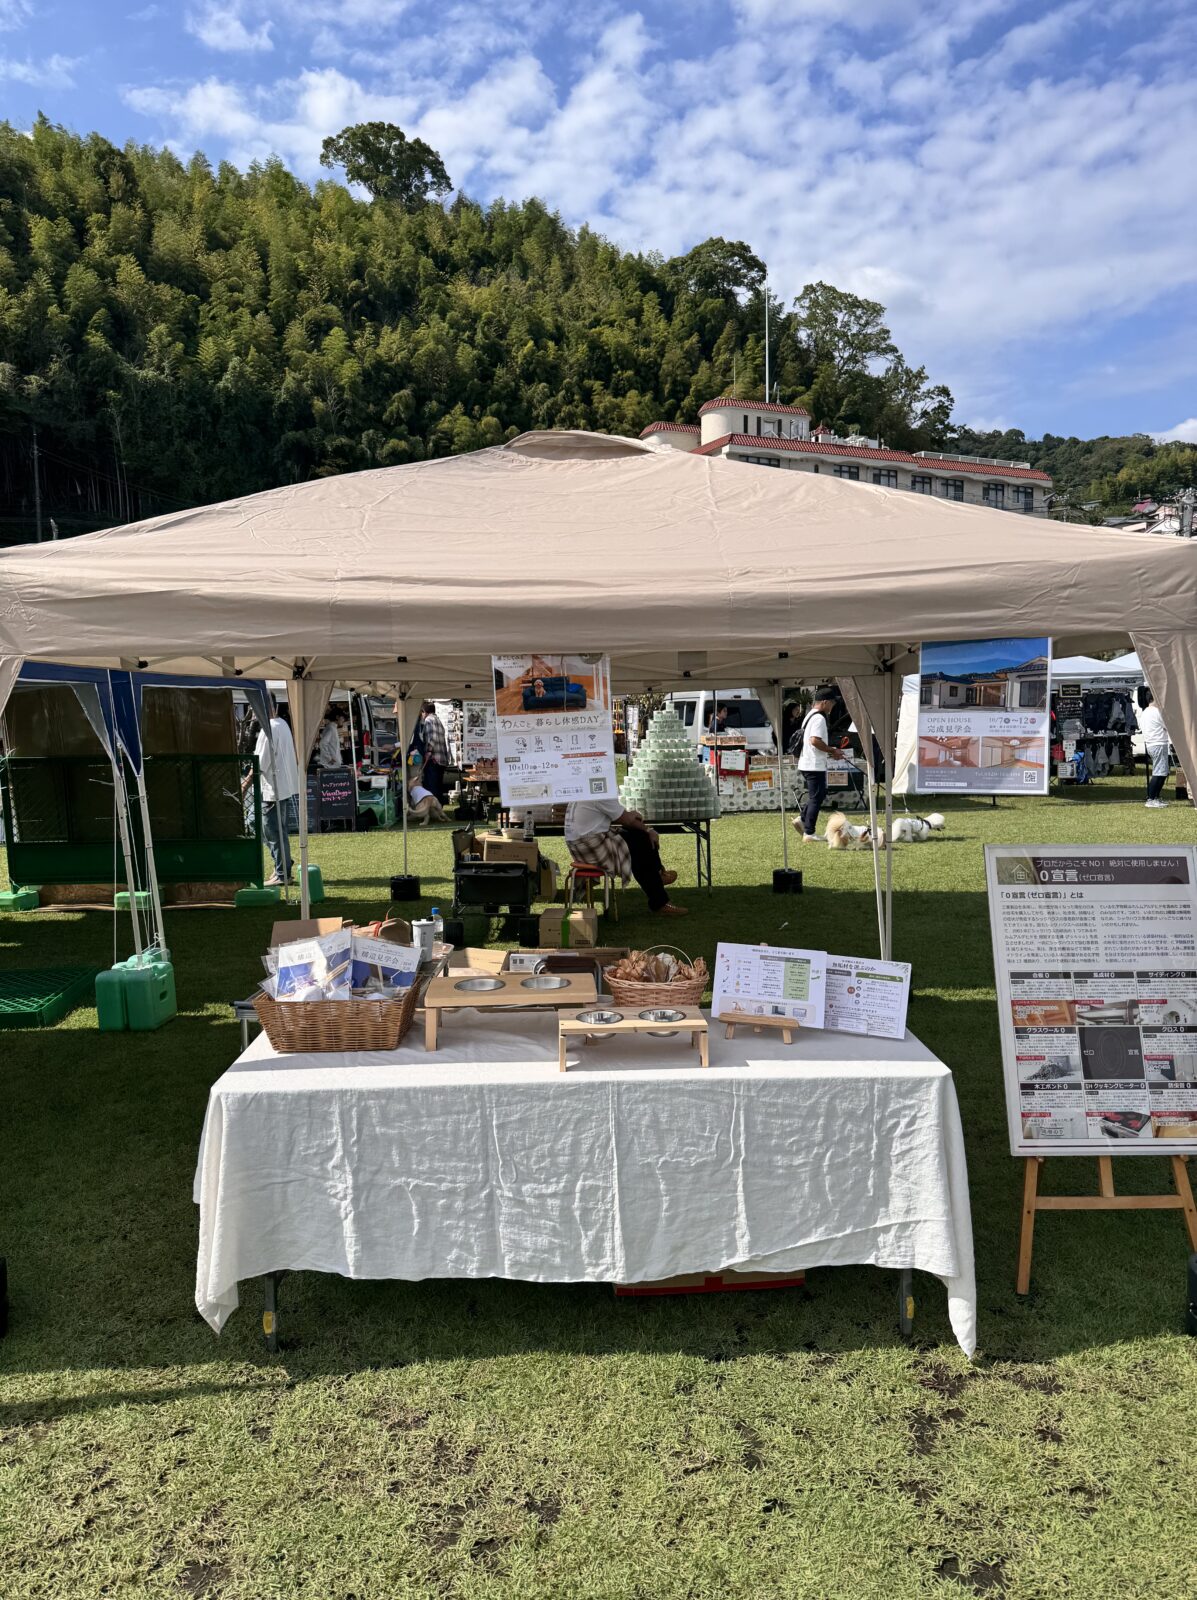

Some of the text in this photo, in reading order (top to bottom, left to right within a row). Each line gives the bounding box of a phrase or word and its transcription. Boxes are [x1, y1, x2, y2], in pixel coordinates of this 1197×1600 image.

[535, 715, 600, 727] 暮らし体感DAY
[927, 725, 972, 733] 完成見学会
[1109, 859, 1180, 868] 絶対に使用しません！
[361, 951, 399, 965] 構造見学会
